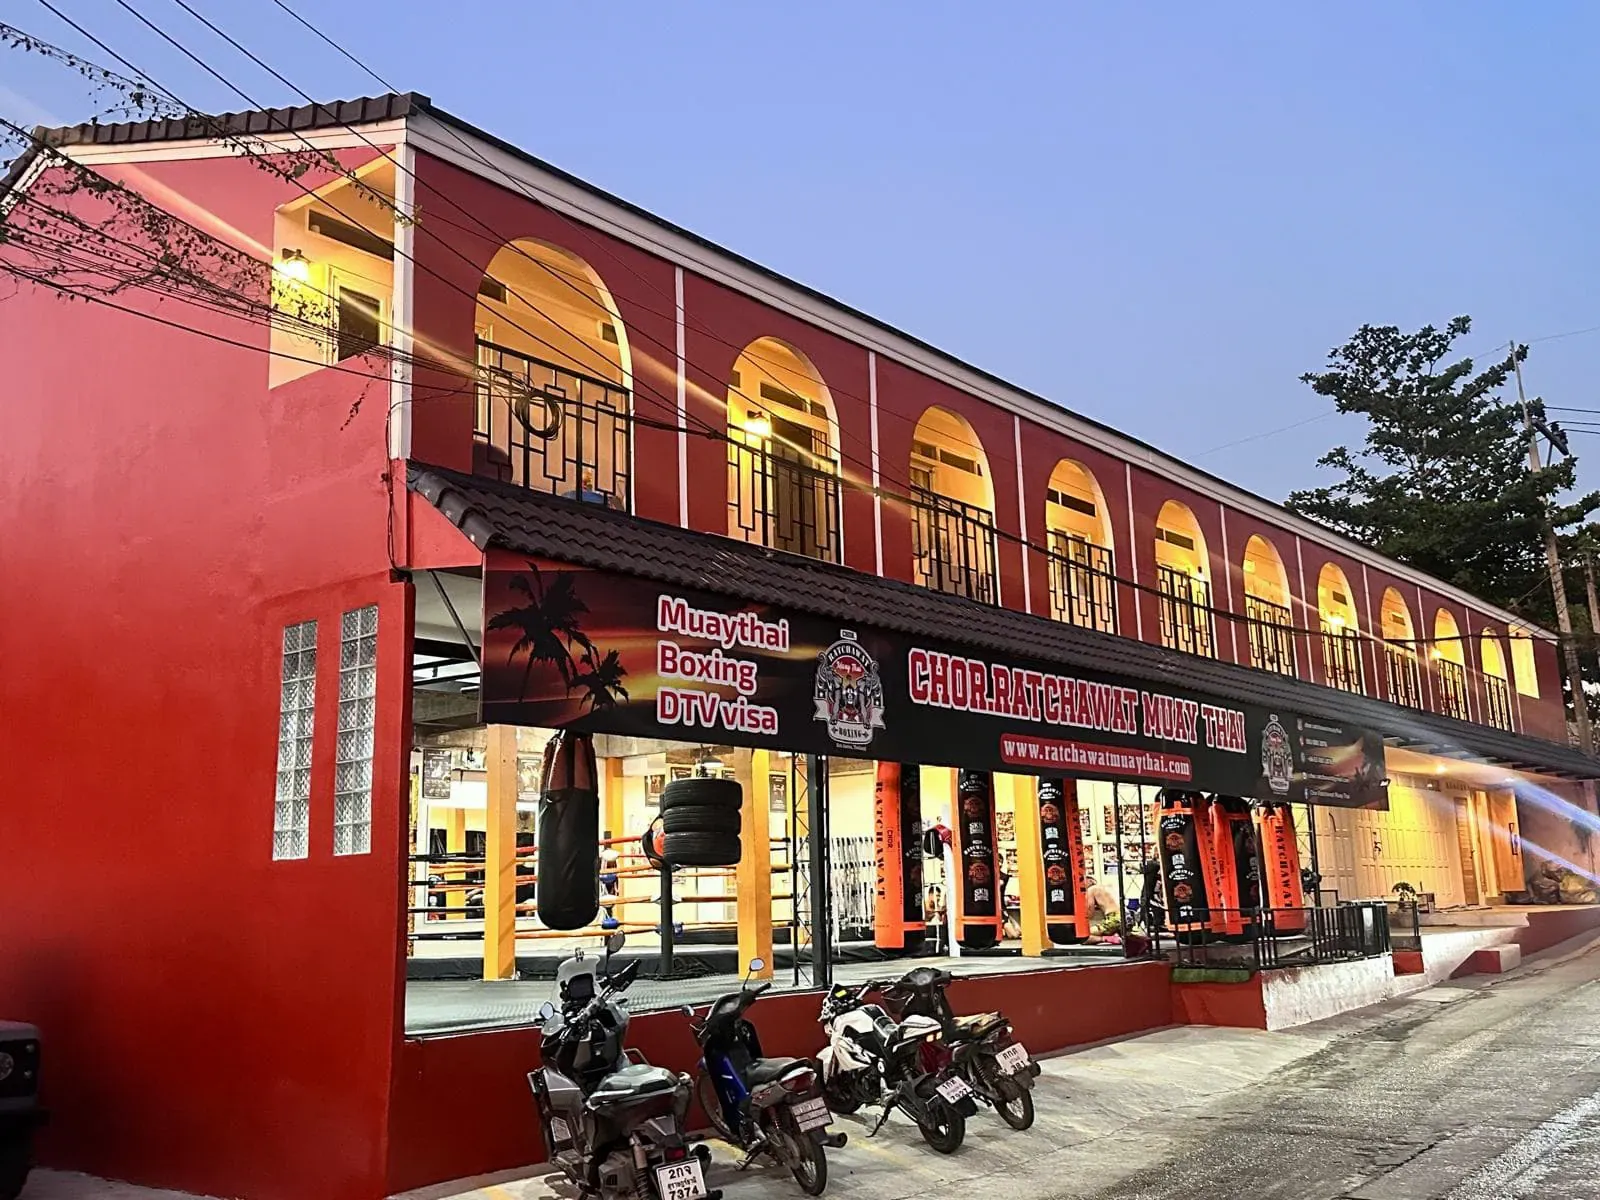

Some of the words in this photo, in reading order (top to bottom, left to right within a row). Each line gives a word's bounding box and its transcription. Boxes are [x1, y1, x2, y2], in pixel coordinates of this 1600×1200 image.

[657, 594, 790, 653] Muaythai
[656, 640, 758, 696] Boxing
[656, 684, 721, 727] DTV
[719, 695, 779, 735] visa
[1141, 691, 1199, 745] MUAY
[1201, 705, 1247, 754] THAI
[1003, 738, 1192, 777] www.ratchawatmuaythai.com
[876, 781, 886, 900] RATCHAWAT
[1275, 825, 1293, 907] RATCHAWAT
[668, 1165, 692, 1179] 2กจ
[668, 1185, 700, 1200] 7374
